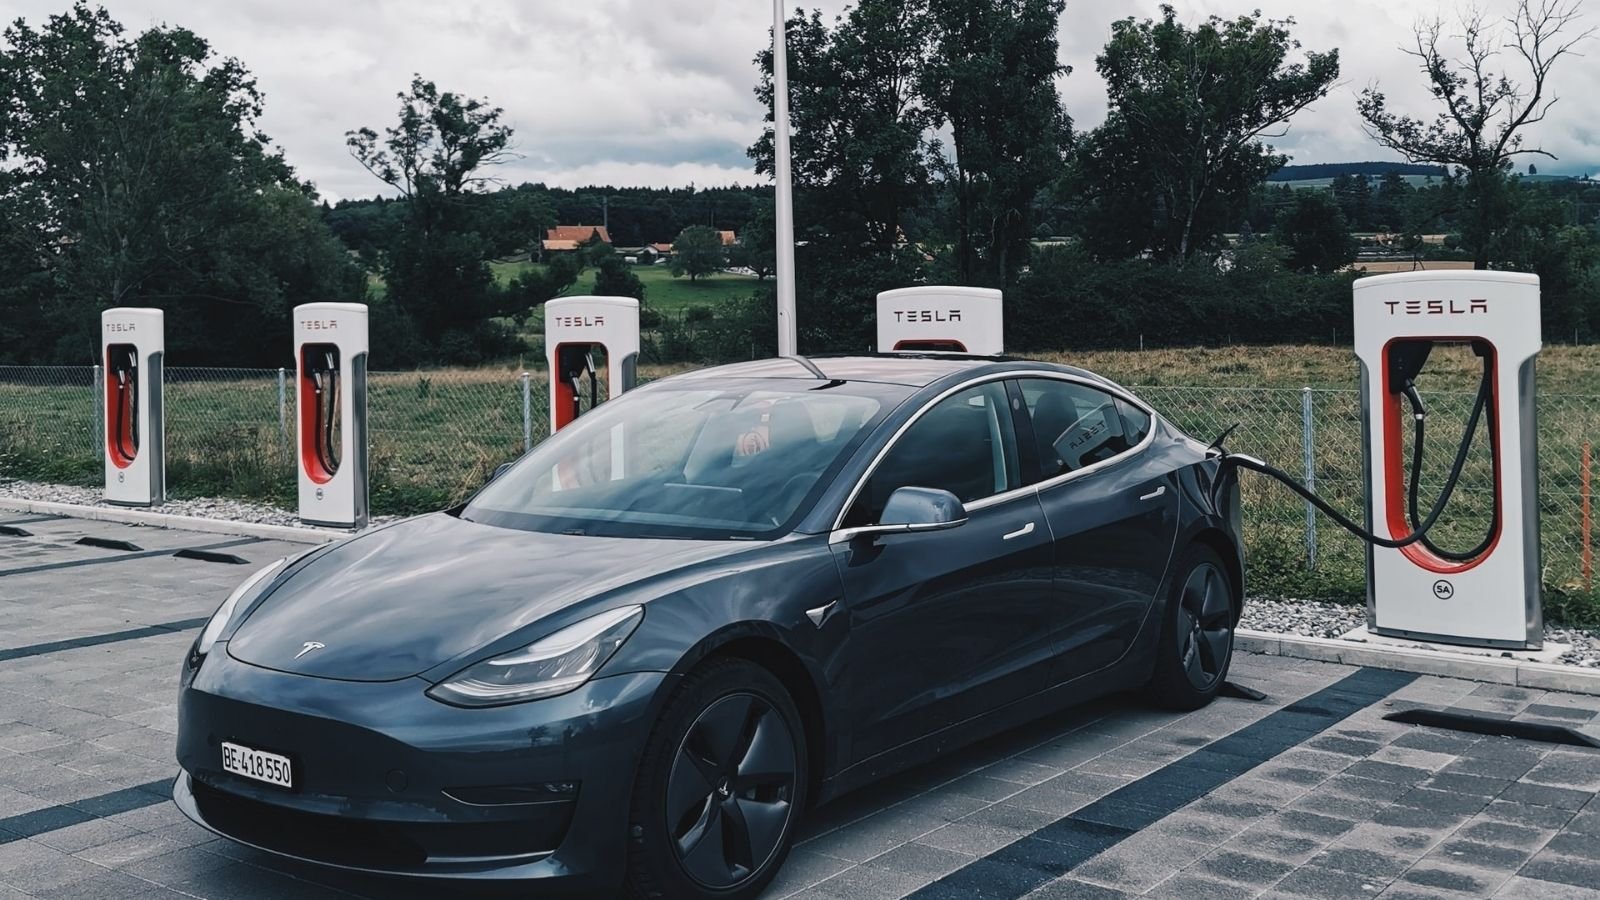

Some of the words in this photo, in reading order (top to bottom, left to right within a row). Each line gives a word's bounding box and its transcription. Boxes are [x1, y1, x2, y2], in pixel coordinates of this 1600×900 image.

[1384, 299, 1487, 315] TESLA
[555, 316, 604, 327] TESLA
[893, 310, 961, 322] TESLA
[106, 323, 136, 332] TESLA
[300, 320, 337, 329] TESLA
